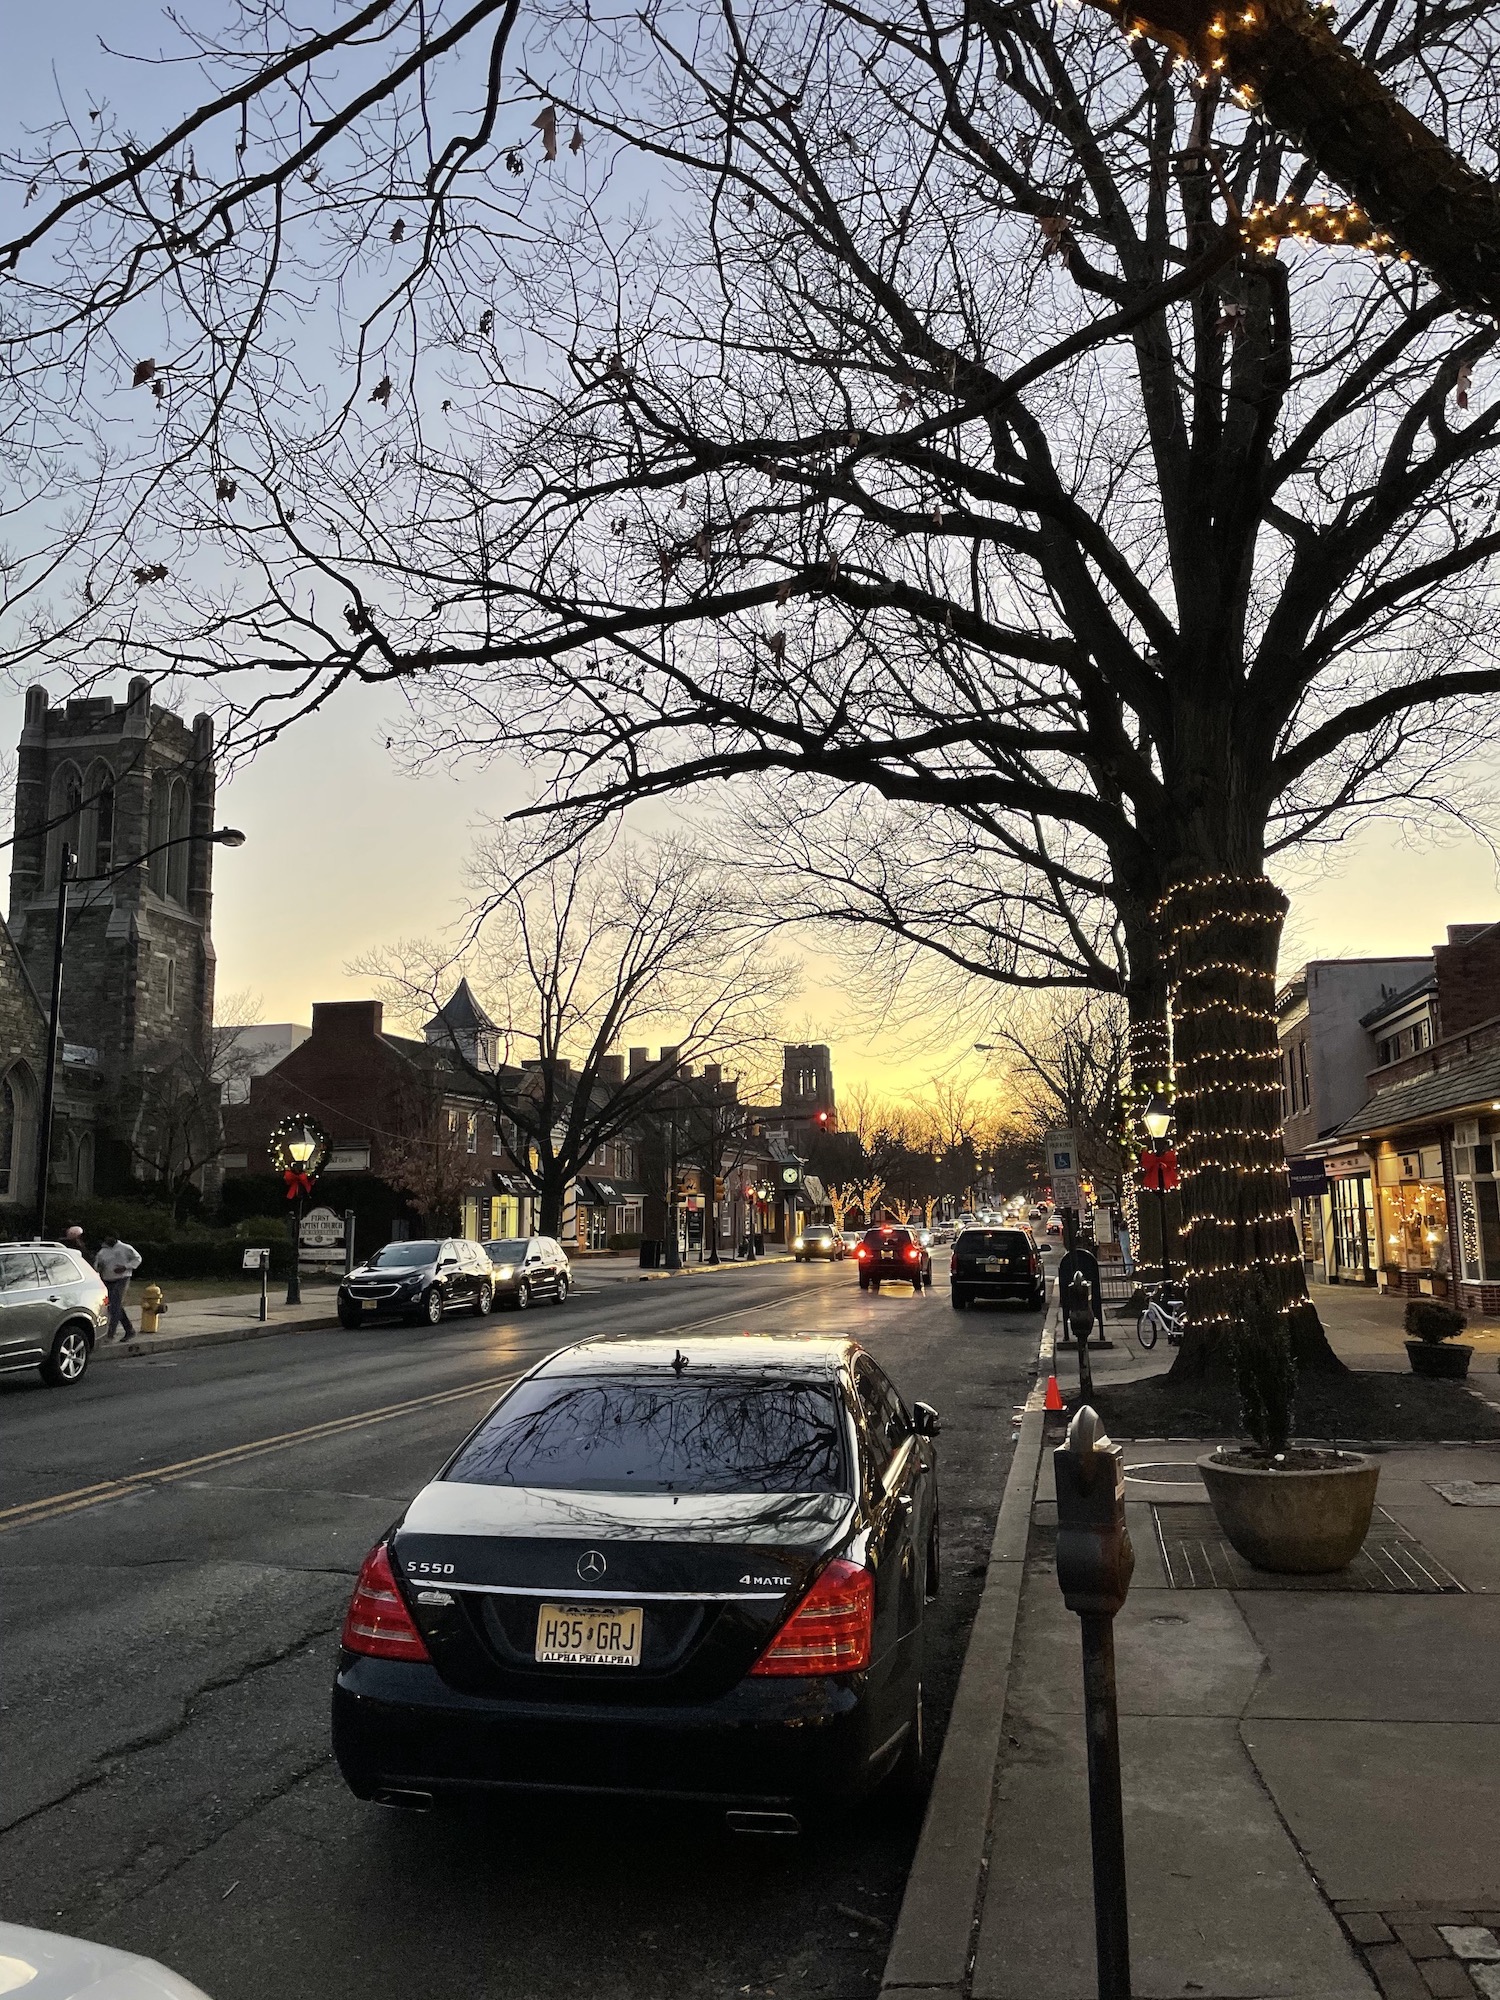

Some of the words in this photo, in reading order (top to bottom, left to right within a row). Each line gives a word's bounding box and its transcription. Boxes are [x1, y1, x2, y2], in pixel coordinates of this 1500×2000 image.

[1049, 1141, 1072, 1149] PARKING
[545, 1620, 583, 1648] H35
[596, 1622, 635, 1651] GRJ
[544, 1653, 577, 1662] ALPHA
[579, 1654, 596, 1663] PHI
[597, 1655, 630, 1664] ALPHA
